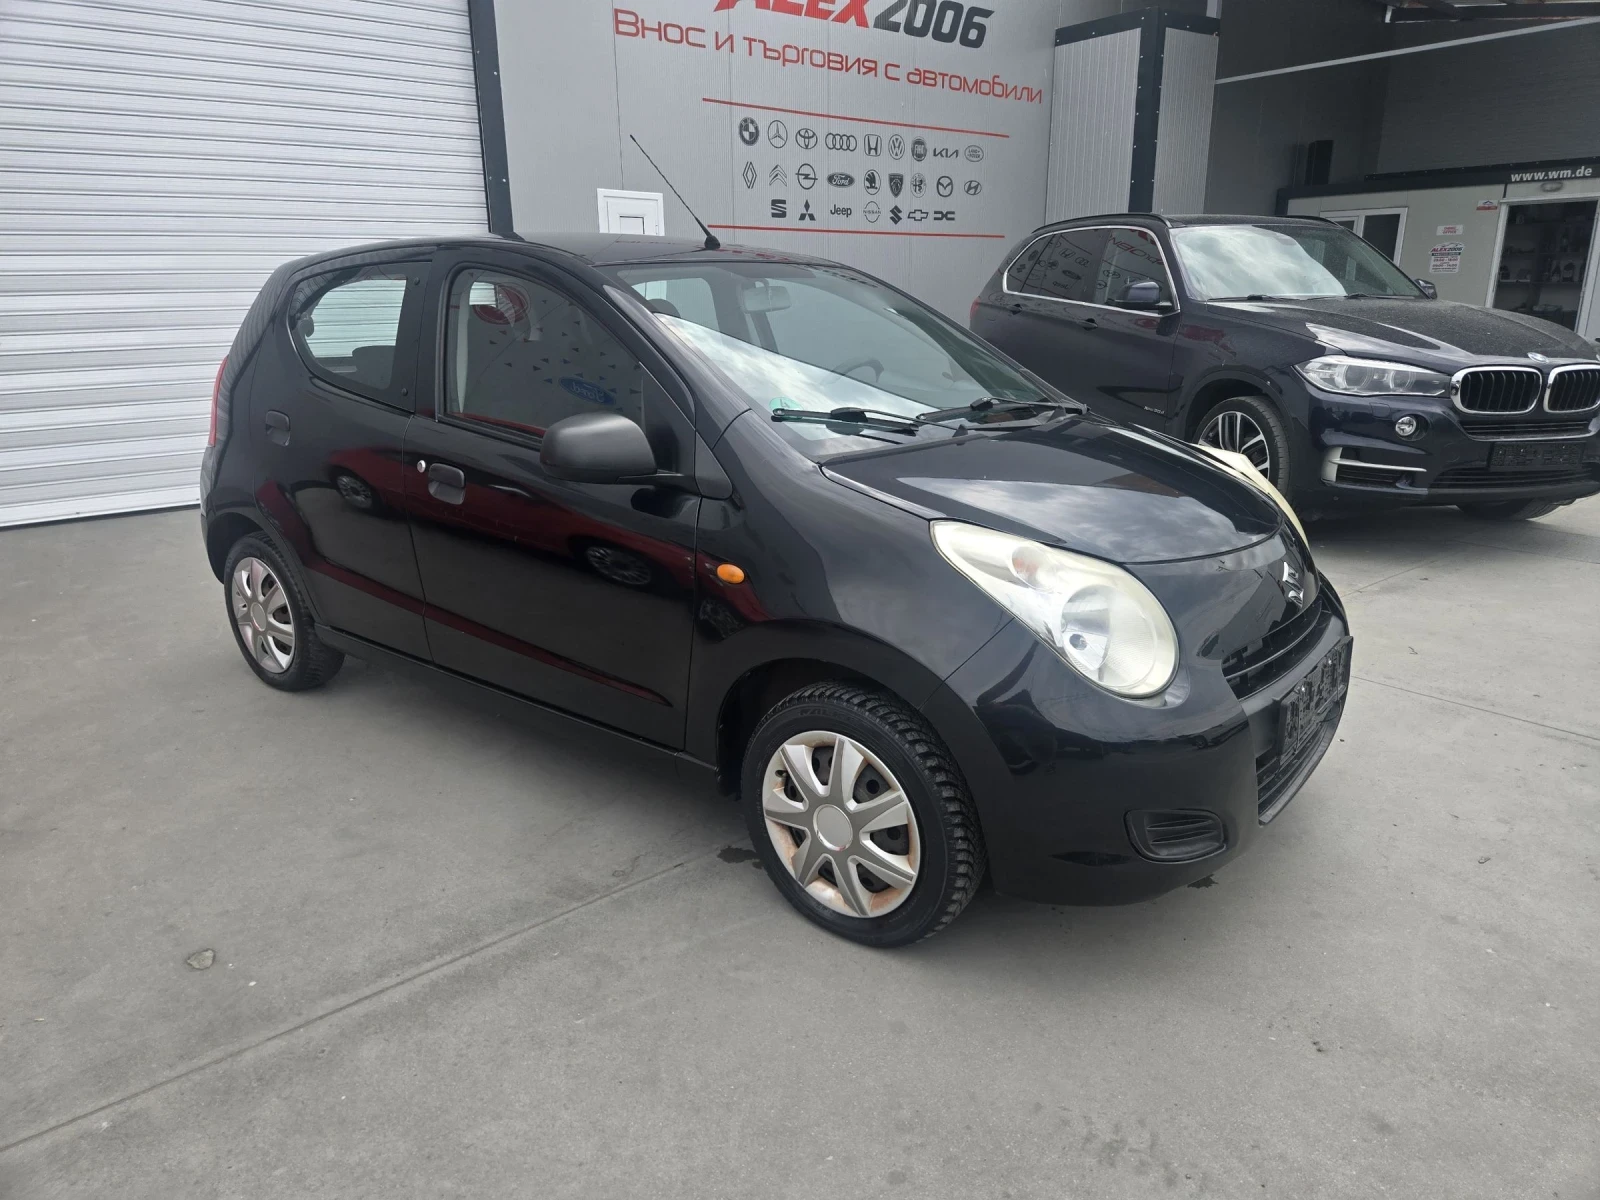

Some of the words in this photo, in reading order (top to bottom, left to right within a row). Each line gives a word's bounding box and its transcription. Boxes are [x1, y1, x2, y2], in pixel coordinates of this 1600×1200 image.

[613, 8, 706, 49] Внос
[742, 36, 878, 77] търговия
[906, 68, 1043, 104] автомобили
[832, 174, 850, 185] Ford
[1510, 165, 1592, 181] www.wm.de
[830, 204, 852, 218] Jeep
